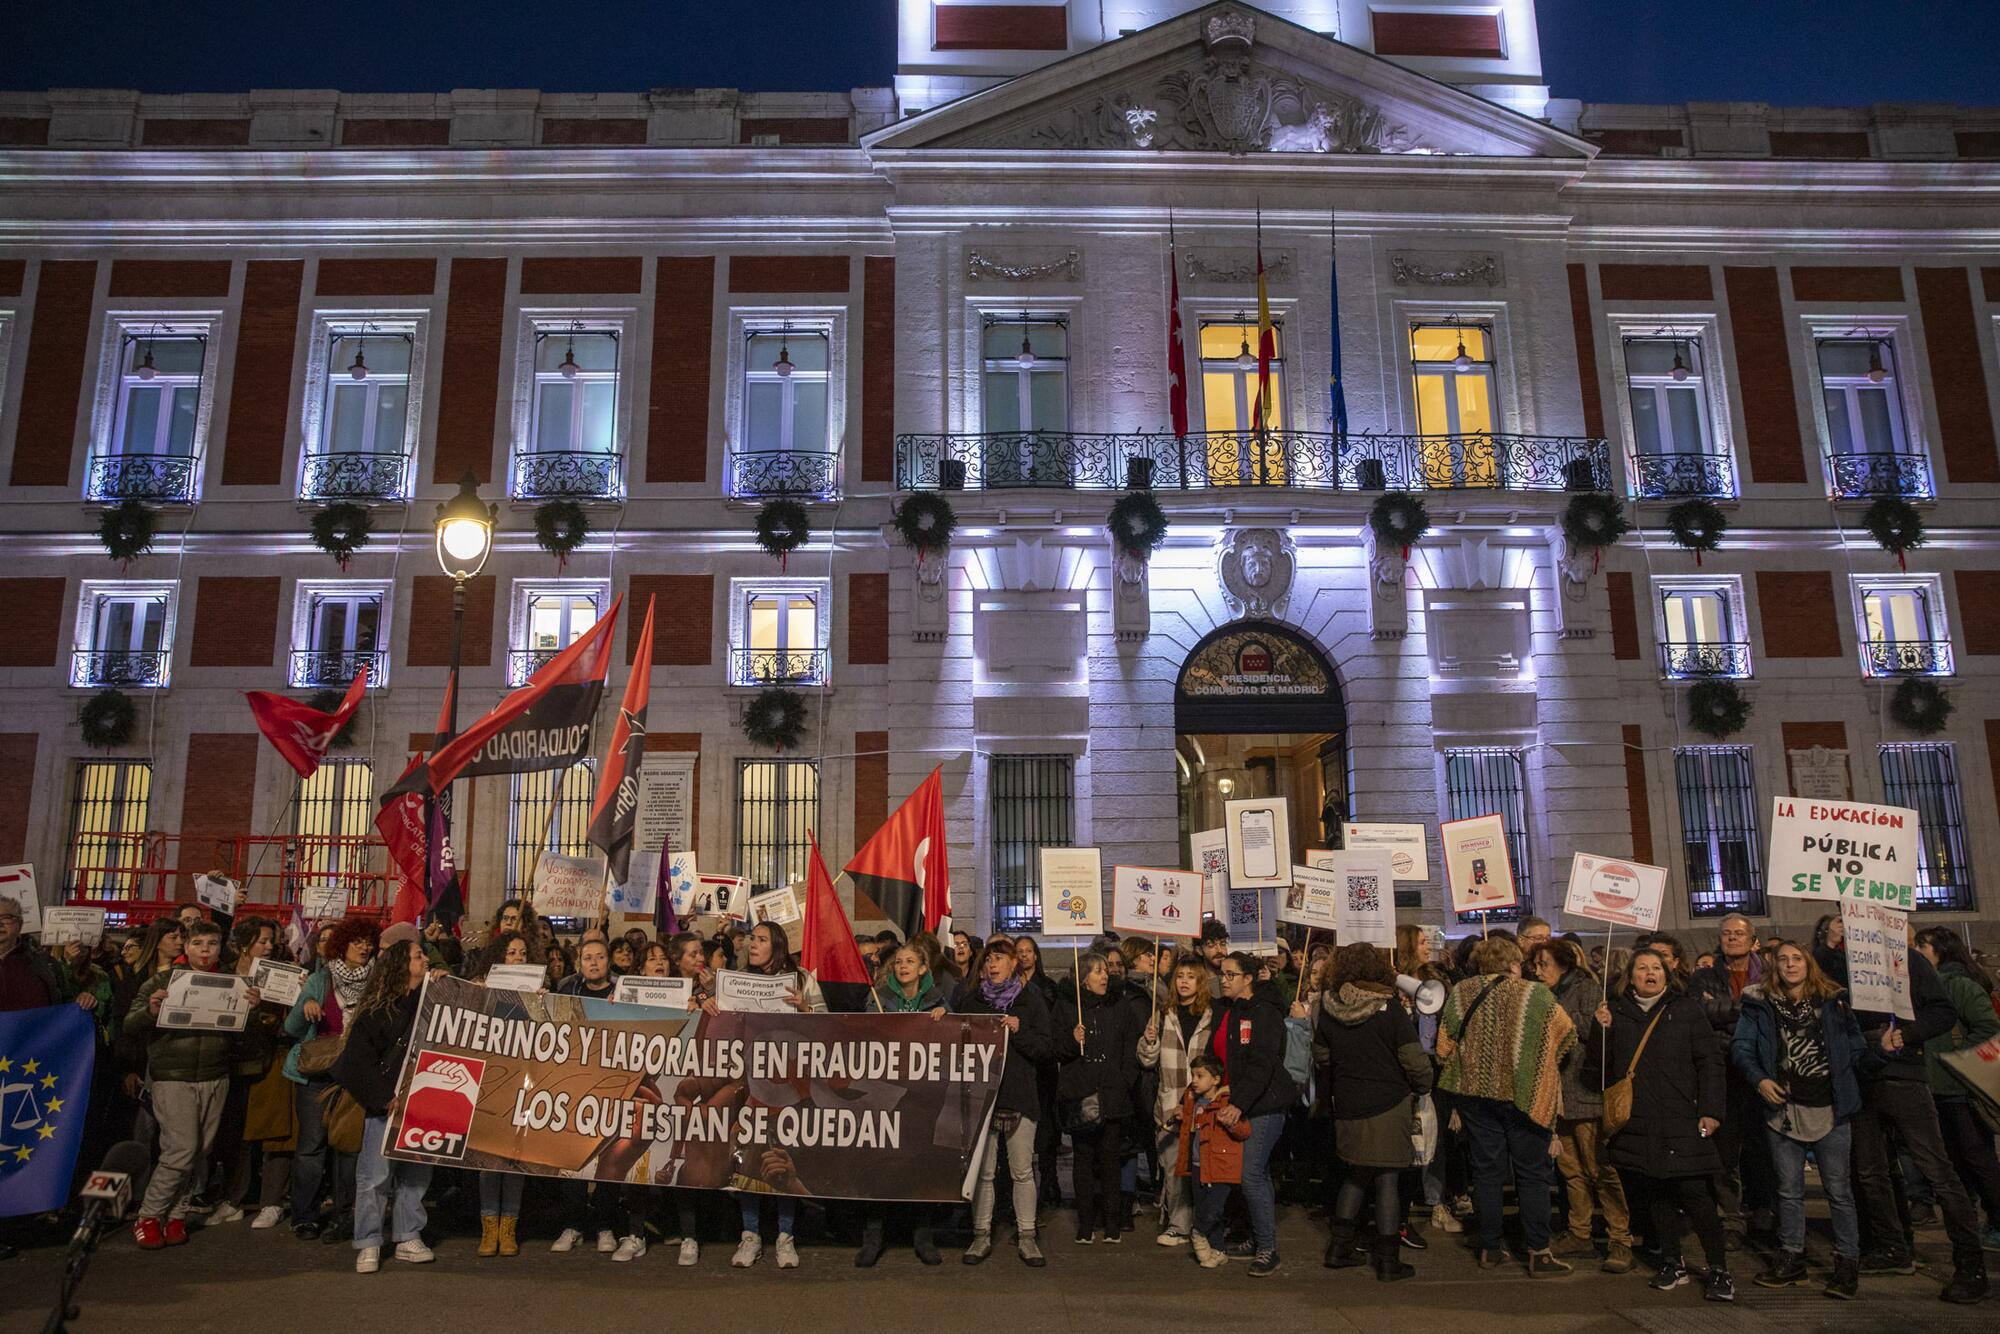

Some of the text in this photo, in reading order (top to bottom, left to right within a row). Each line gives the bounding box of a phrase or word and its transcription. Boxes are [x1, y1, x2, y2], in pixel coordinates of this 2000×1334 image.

[1222, 674, 1291, 683] PRESIDENCIA
[1195, 686, 1319, 695] COMUNIDAD DE MADRID
[1778, 803, 1903, 829] LA EDUCACIÓN
[1803, 833, 1897, 862] PÚBLICA
[1828, 858, 1864, 875] NO
[547, 876, 593, 888] CUIDAMOS
[1792, 873, 1912, 906] SE VENDE
[536, 884, 548, 893] LA
[556, 887, 575, 896] CAM
[1311, 888, 1330, 896] 00000
[546, 897, 604, 911] ABANDON
[729, 978, 751, 987] ¿Quién
[426, 1004, 571, 1063] INTERINOS
[580, 1026, 595, 1065] Y
[601, 1030, 744, 1080] LABORALES
[752, 1041, 788, 1079] EN
[796, 1041, 900, 1080] FRAUDE
[908, 1042, 941, 1081] DE
[949, 1043, 996, 1083] LEY
[512, 1088, 900, 1149] LOS QUE ESTÁN SE QUEDAN
[404, 1127, 463, 1154] CGT
